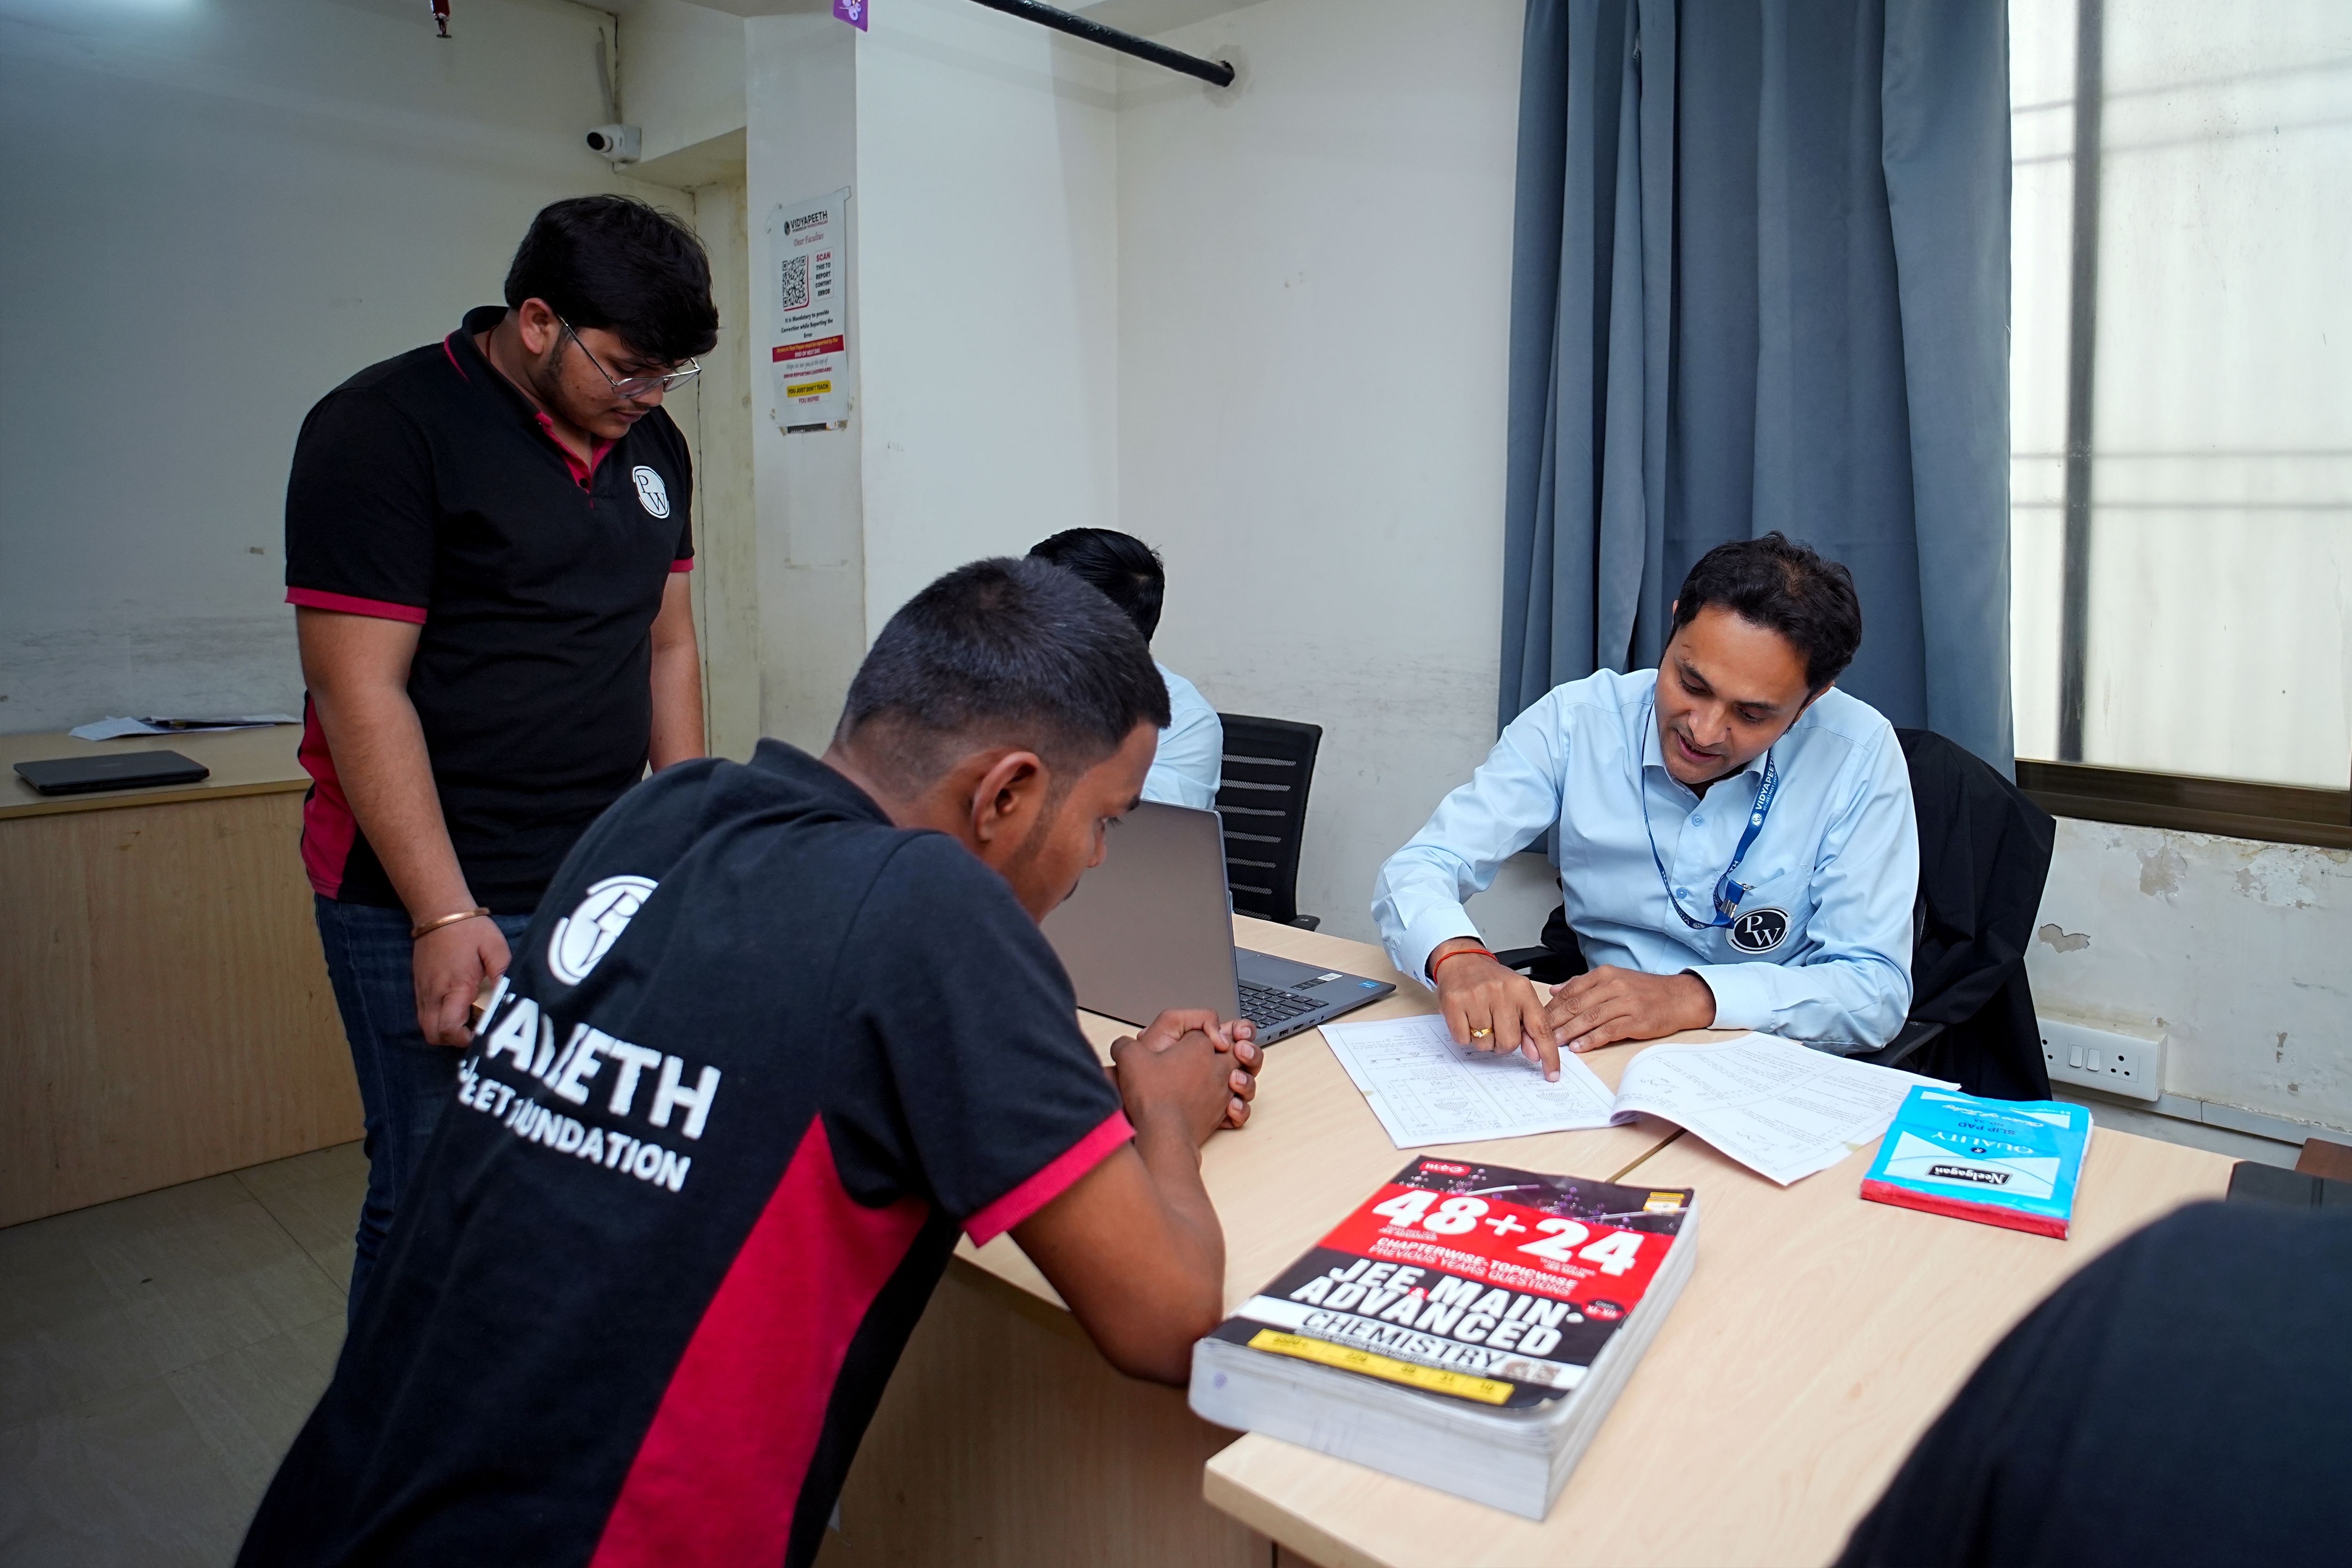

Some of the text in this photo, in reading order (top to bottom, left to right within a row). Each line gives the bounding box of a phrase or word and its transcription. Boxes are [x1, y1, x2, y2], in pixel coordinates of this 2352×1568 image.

[790, 210, 828, 229] VIDYAPEETH
[817, 251, 831, 262] SCAN
[816, 271, 831, 279] REPORT
[815, 280, 832, 288] CONTENT
[818, 288, 830, 297] ERROR
[793, 313, 811, 322] Mandatory
[817, 309, 829, 318] provide
[810, 319, 827, 327] Reporting
[1958, 1122, 2016, 1136] SLIP PAD
[1931, 1131, 2034, 1154] QUALITY
[1934, 1166, 2005, 1185] Neelgagan
[1394, 1230, 1437, 1240] ADVANCED
[1329, 1258, 1426, 1295] JEE
[1368, 1244, 1573, 1296] PREVIOUS YEARS QUESTIONS
[1543, 1263, 1586, 1278] JEE MAIN
[1412, 1288, 1421, 1297] &
[1595, 1300, 1616, 1309] Class
[1290, 1275, 1563, 1357] ADVANCED
[1302, 1310, 1508, 1367] CHEMISTRY
